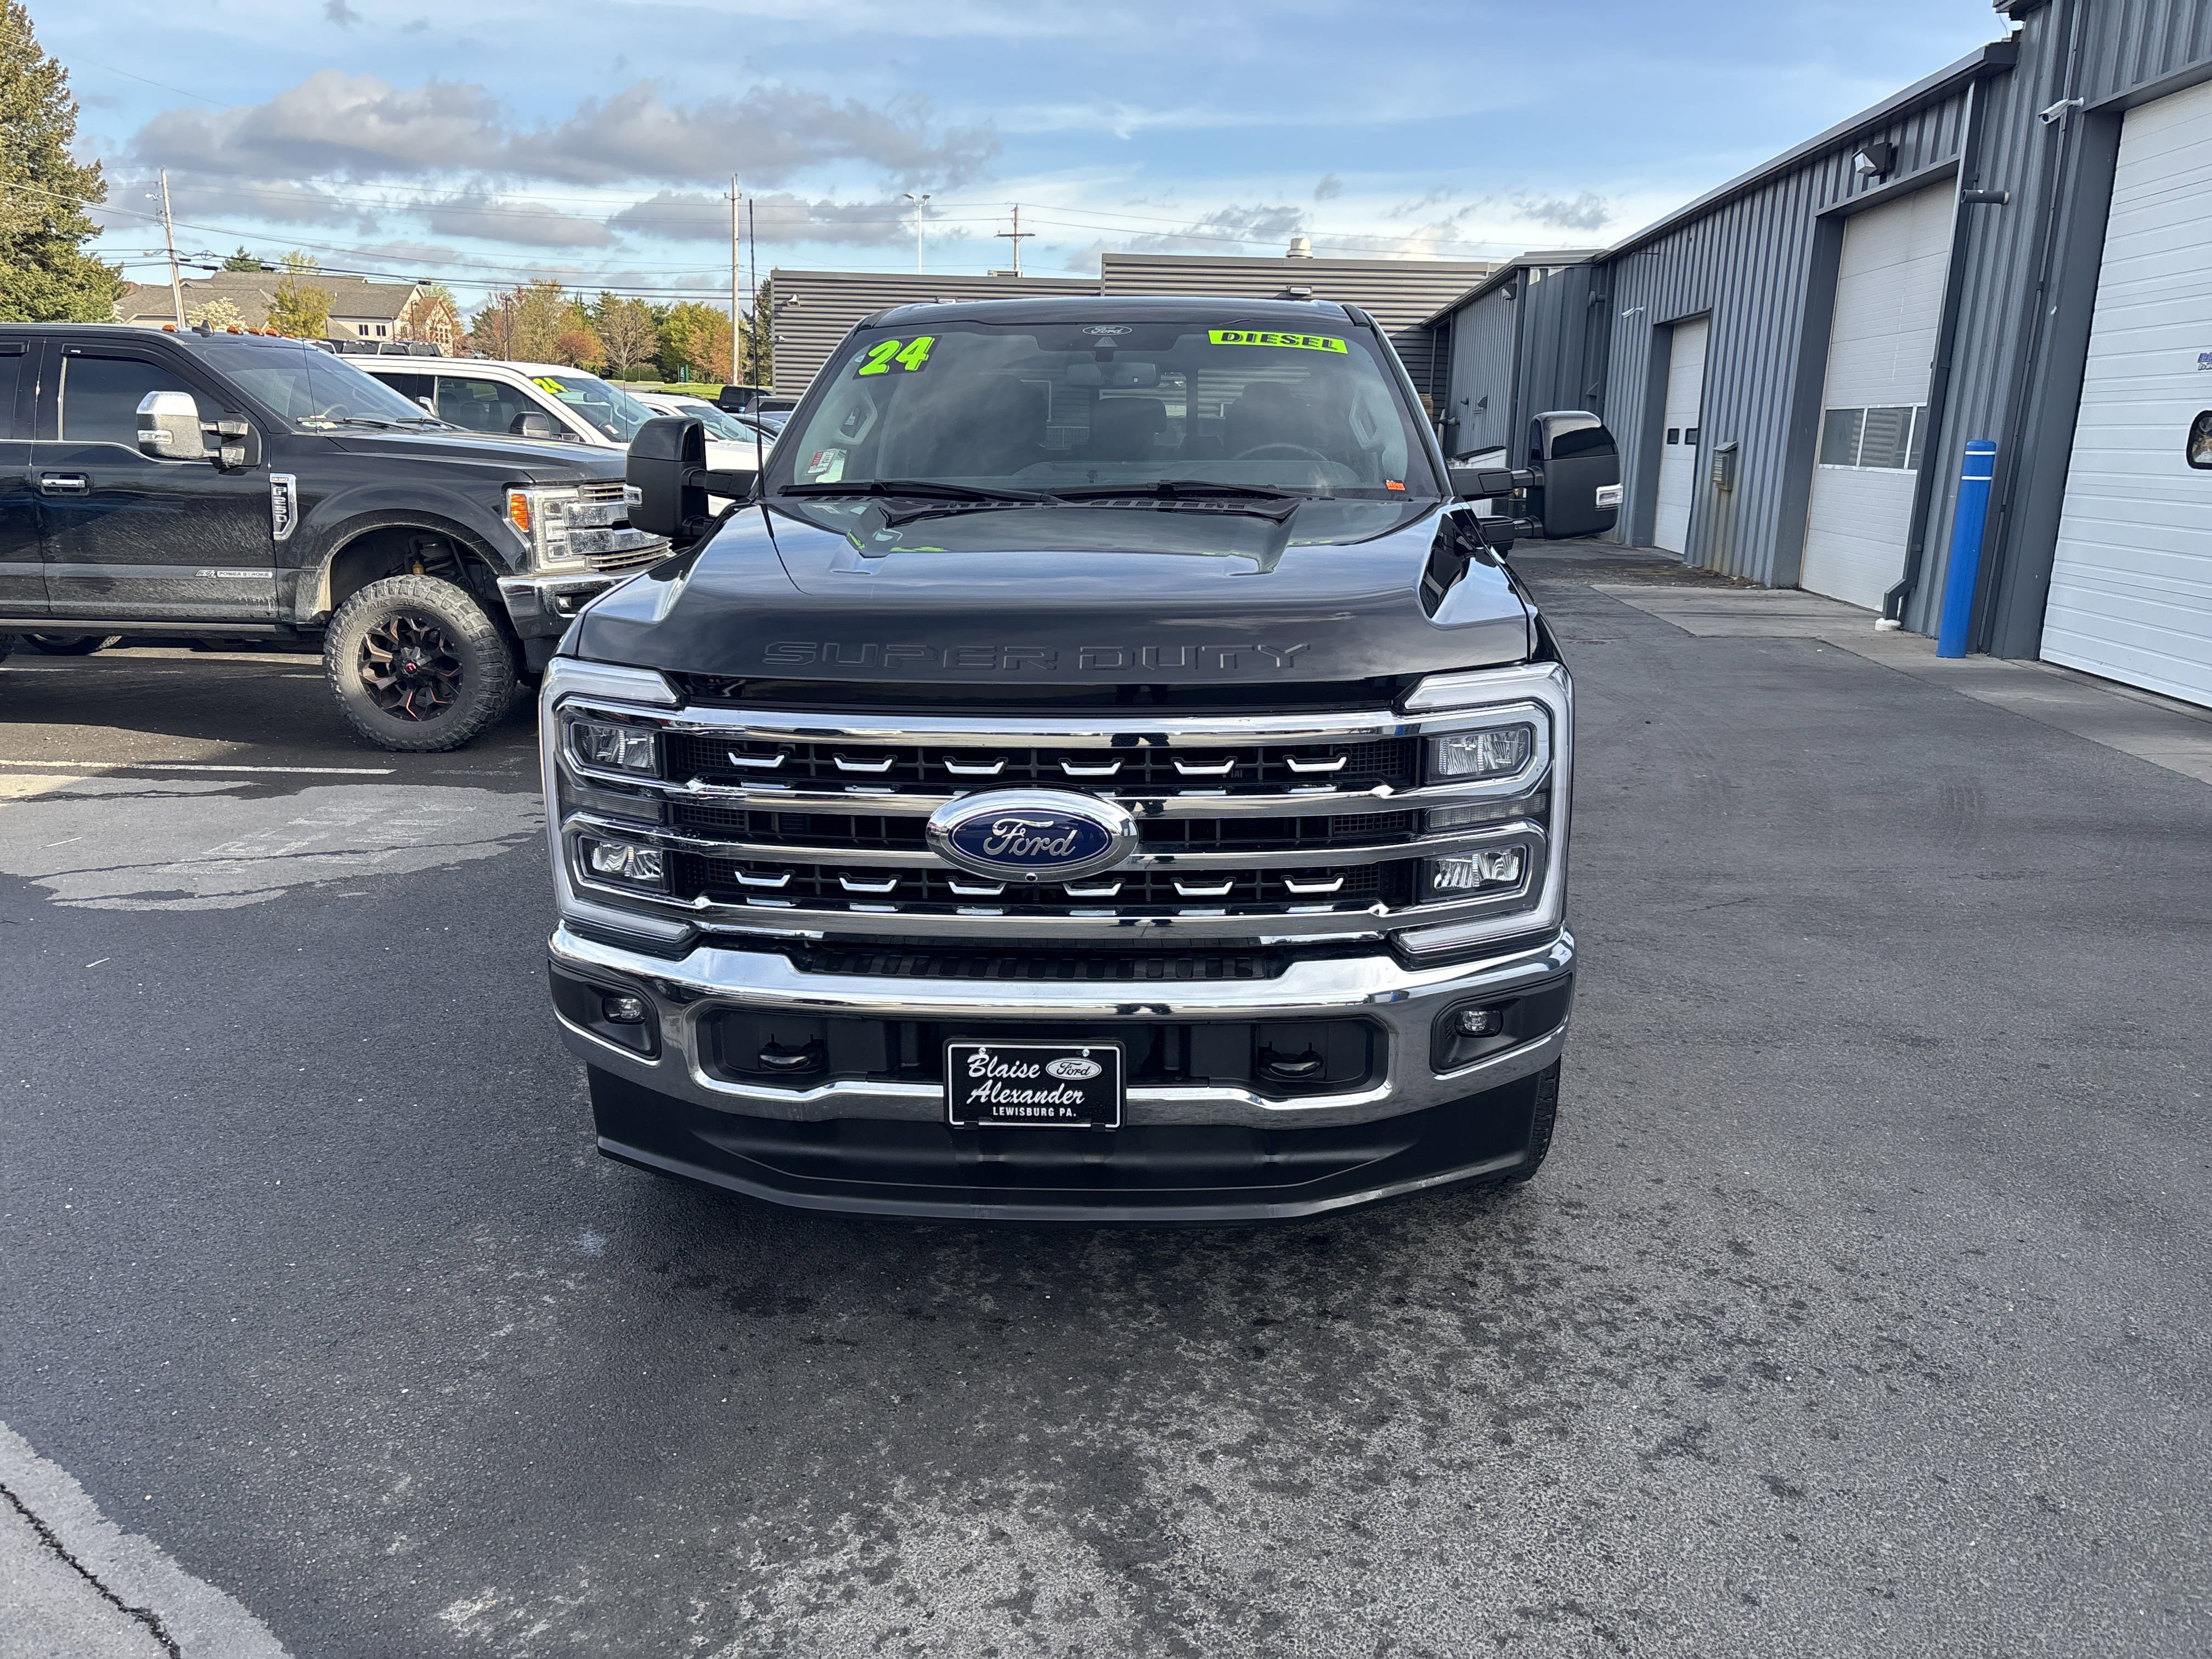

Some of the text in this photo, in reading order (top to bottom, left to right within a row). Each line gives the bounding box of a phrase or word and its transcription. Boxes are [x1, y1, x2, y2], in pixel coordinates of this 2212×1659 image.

[1221, 332, 1338, 350] DIESEL
[859, 336, 935, 375] 24
[764, 641, 1311, 671] SUPER DUTY
[983, 817, 1078, 856] Ford
[967, 1053, 1091, 1078] Blaise Ford
[966, 1079, 1085, 1104] Alexander
[992, 1107, 1076, 1117] LEWISBURG PA.
